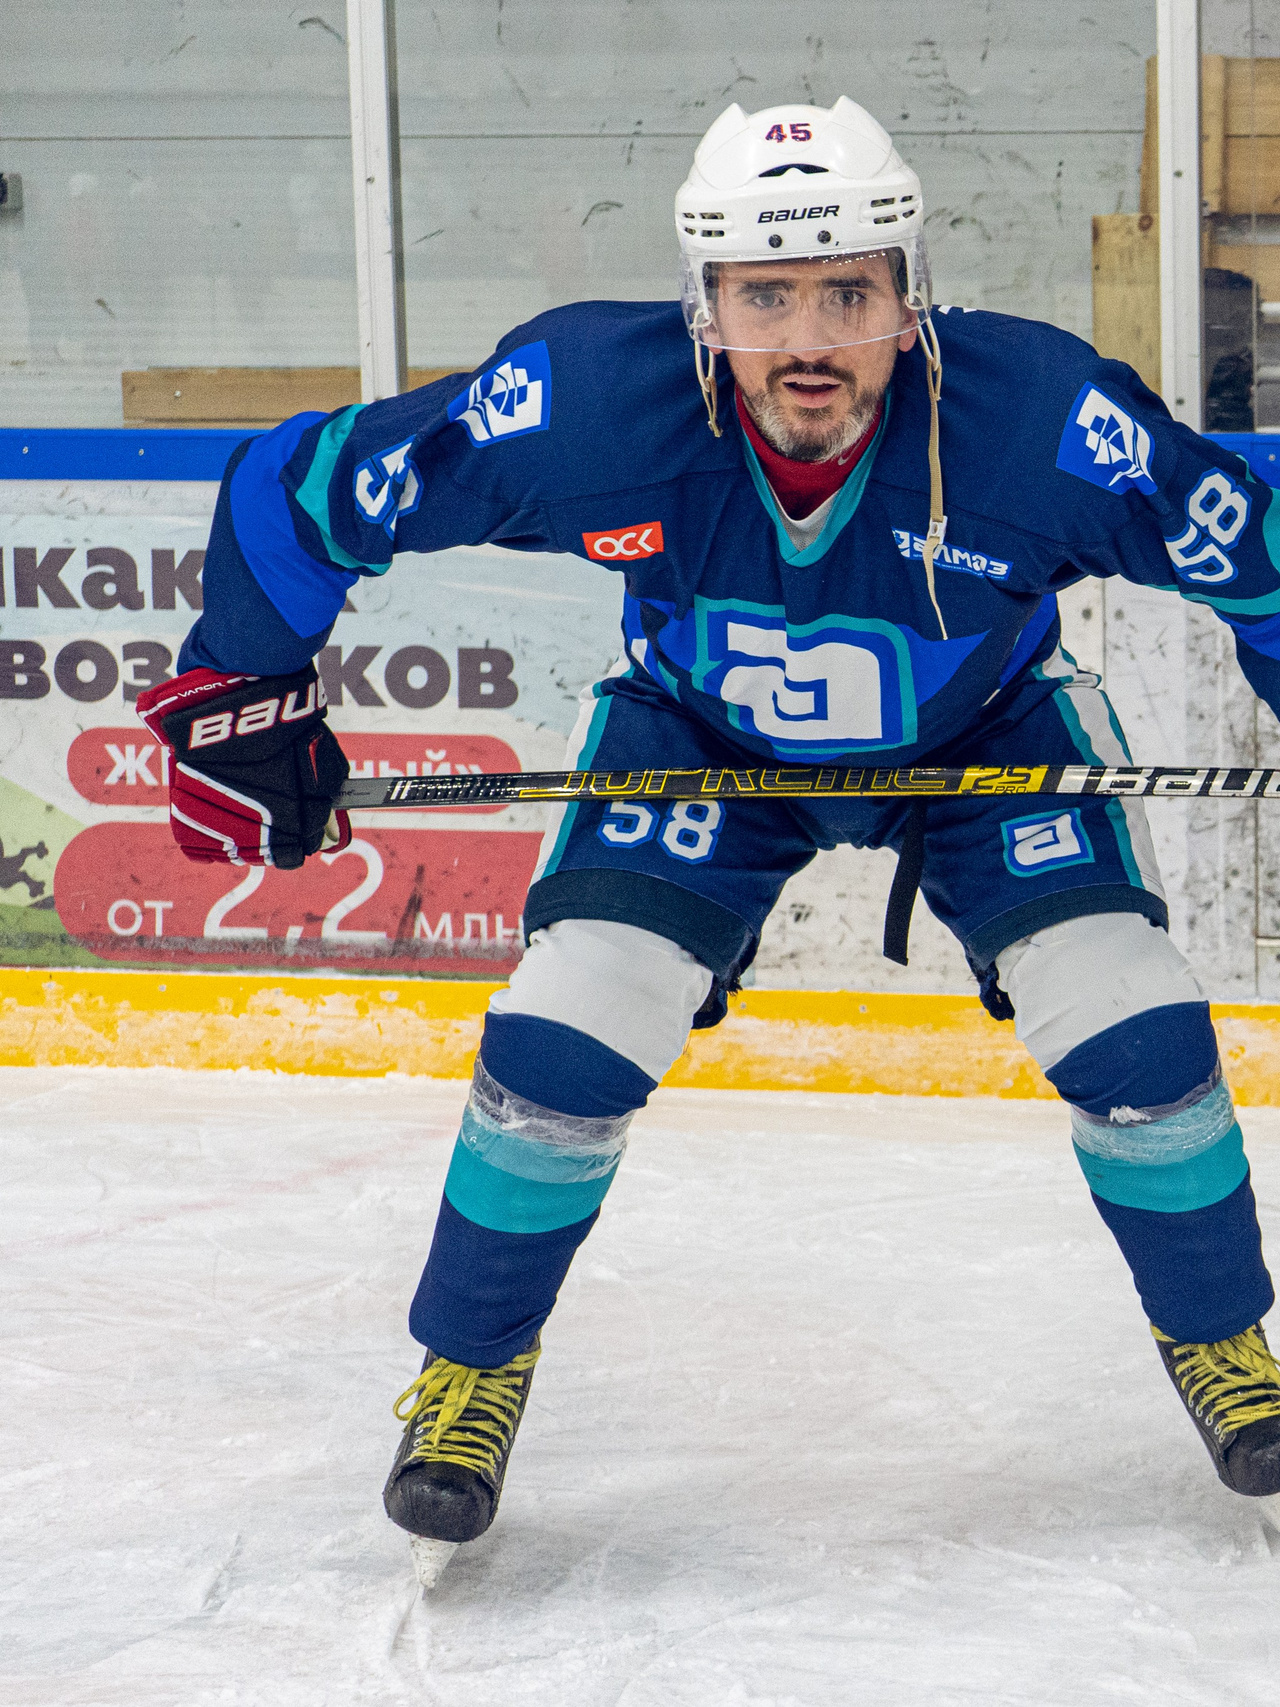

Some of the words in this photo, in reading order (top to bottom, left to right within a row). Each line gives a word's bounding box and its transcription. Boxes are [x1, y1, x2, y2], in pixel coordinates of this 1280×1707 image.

[765, 122, 813, 143] 45
[1163, 468, 1251, 584] 58
[0, 639, 519, 709] возков
[178, 681, 226, 698] VAPOR
[599, 800, 724, 862] 58
[203, 838, 387, 944] 2,2
